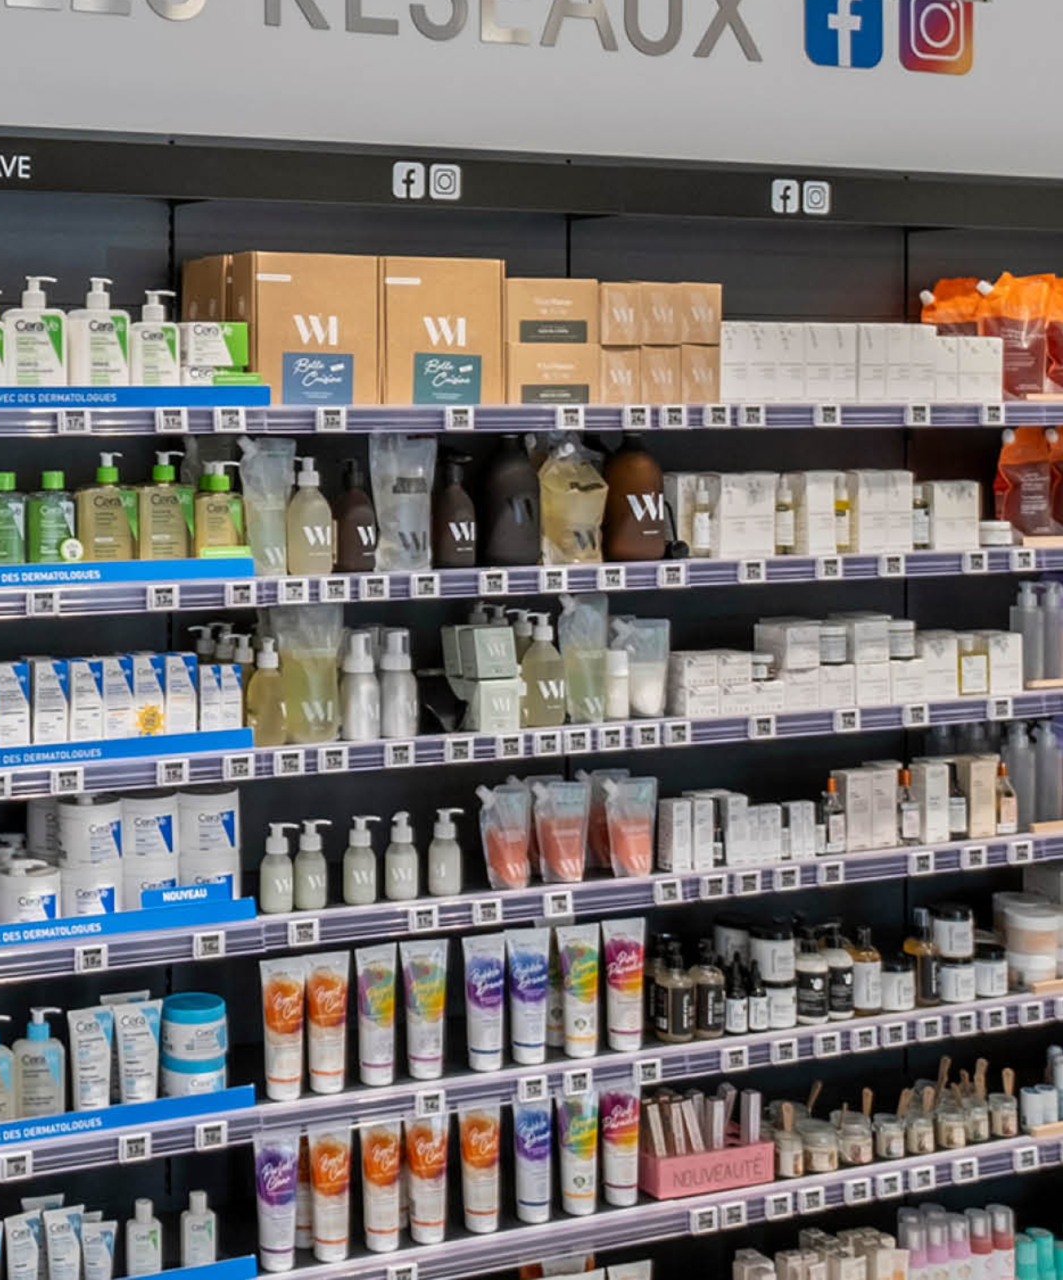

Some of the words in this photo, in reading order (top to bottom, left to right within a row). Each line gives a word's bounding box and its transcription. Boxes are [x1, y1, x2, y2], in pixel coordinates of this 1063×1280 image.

[15, 320, 59, 333] CeraVe
[17, 392, 36, 404] DES
[38, 392, 118, 404] DERMATOLOGUES
[1, 571, 20, 583] DES
[21, 569, 101, 582] DERMATOLOGUES
[2, 753, 22, 765] DES
[23, 748, 103, 763] DERMATOLOGUES
[162, 888, 208, 902] NOUVEAU
[2, 930, 22, 943] DES
[23, 922, 103, 939] DERMATOLOGUES
[3, 1128, 22, 1141] DES
[23, 1117, 103, 1137] DERMATOLOGUES
[672, 1154, 766, 1188] NOUVEAUTÉ
